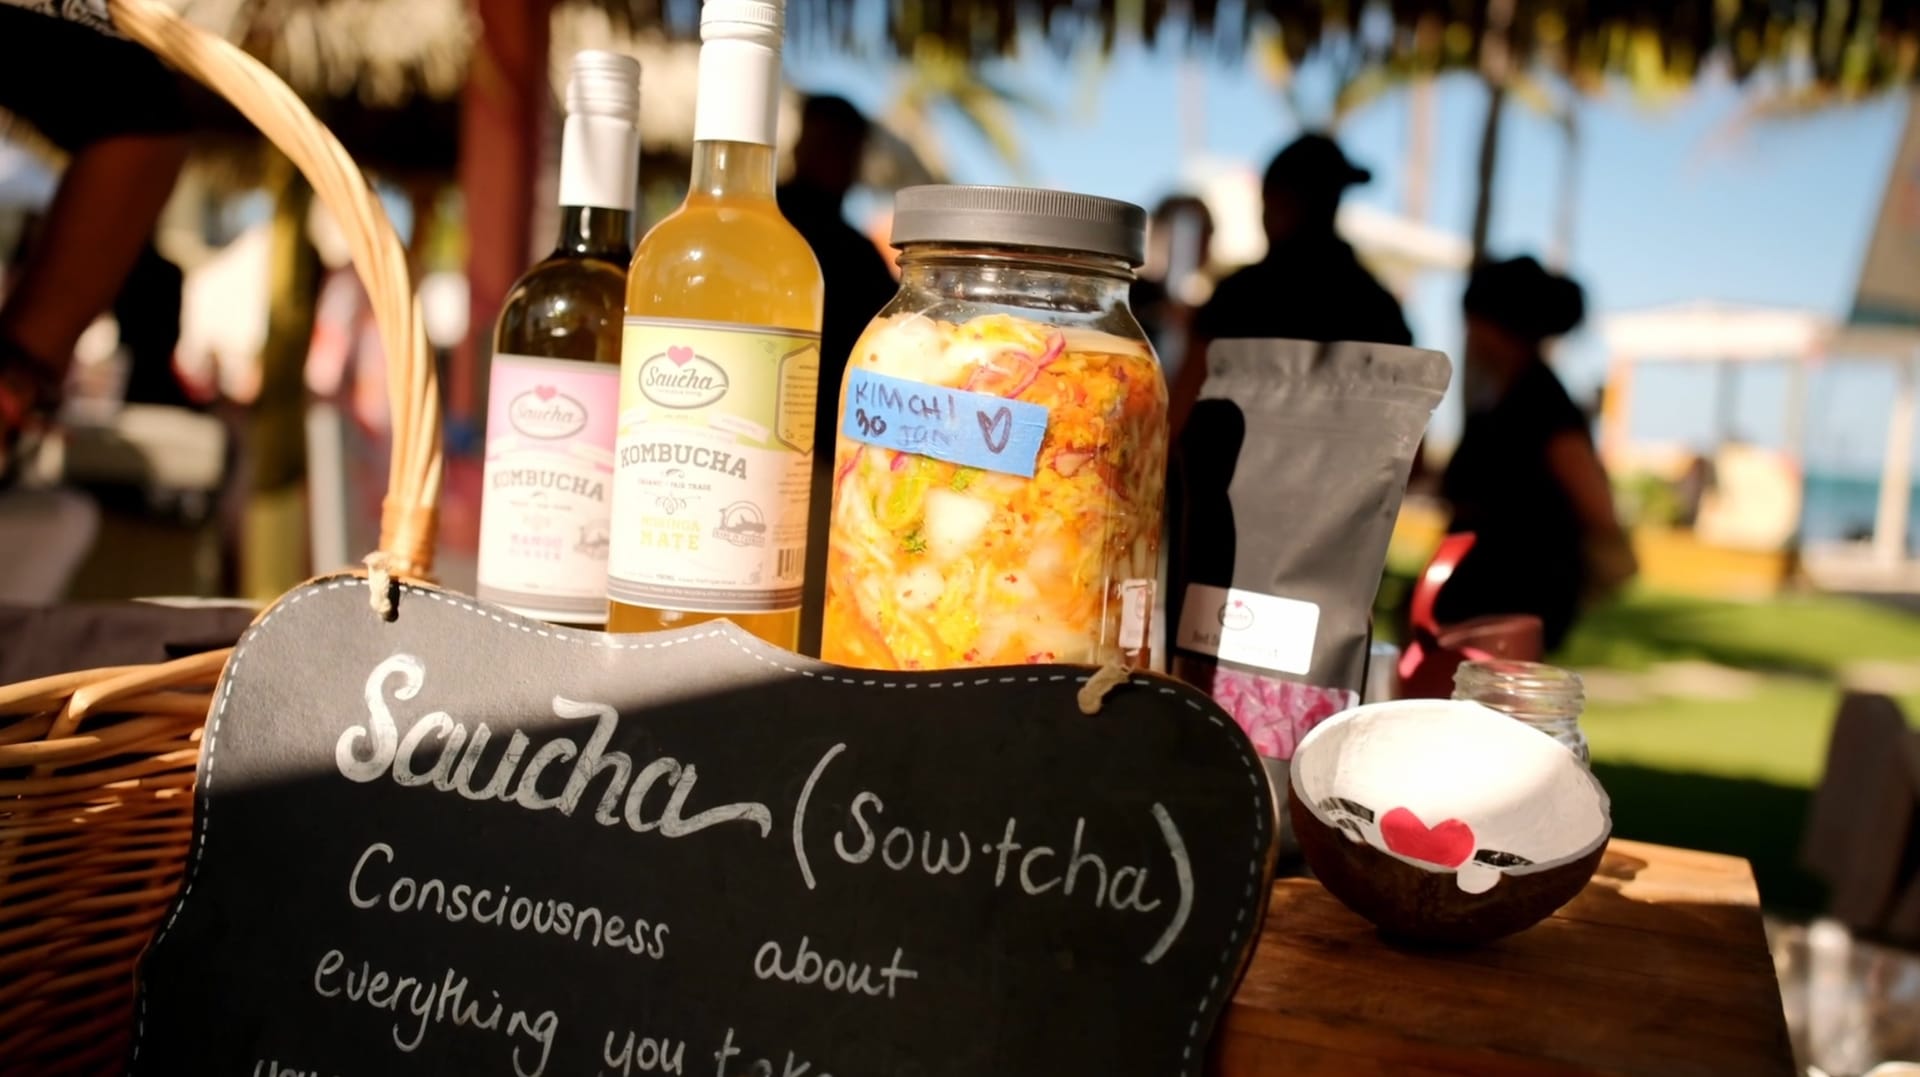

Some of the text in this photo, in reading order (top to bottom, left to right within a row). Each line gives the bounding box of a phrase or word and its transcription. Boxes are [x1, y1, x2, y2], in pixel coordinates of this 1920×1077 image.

[646, 366, 729, 390] Saucha
[855, 381, 956, 421] KIMCHI
[855, 408, 887, 437] 30
[620, 442, 748, 480] KOMBUCHA
[491, 467, 607, 502] KOMBUCHA
[640, 530, 700, 551] MATE
[335, 653, 772, 838] Saucha
[348, 843, 918, 998] Consciousness about
[314, 949, 560, 1077] everything
[600, 1029, 686, 1077] you
